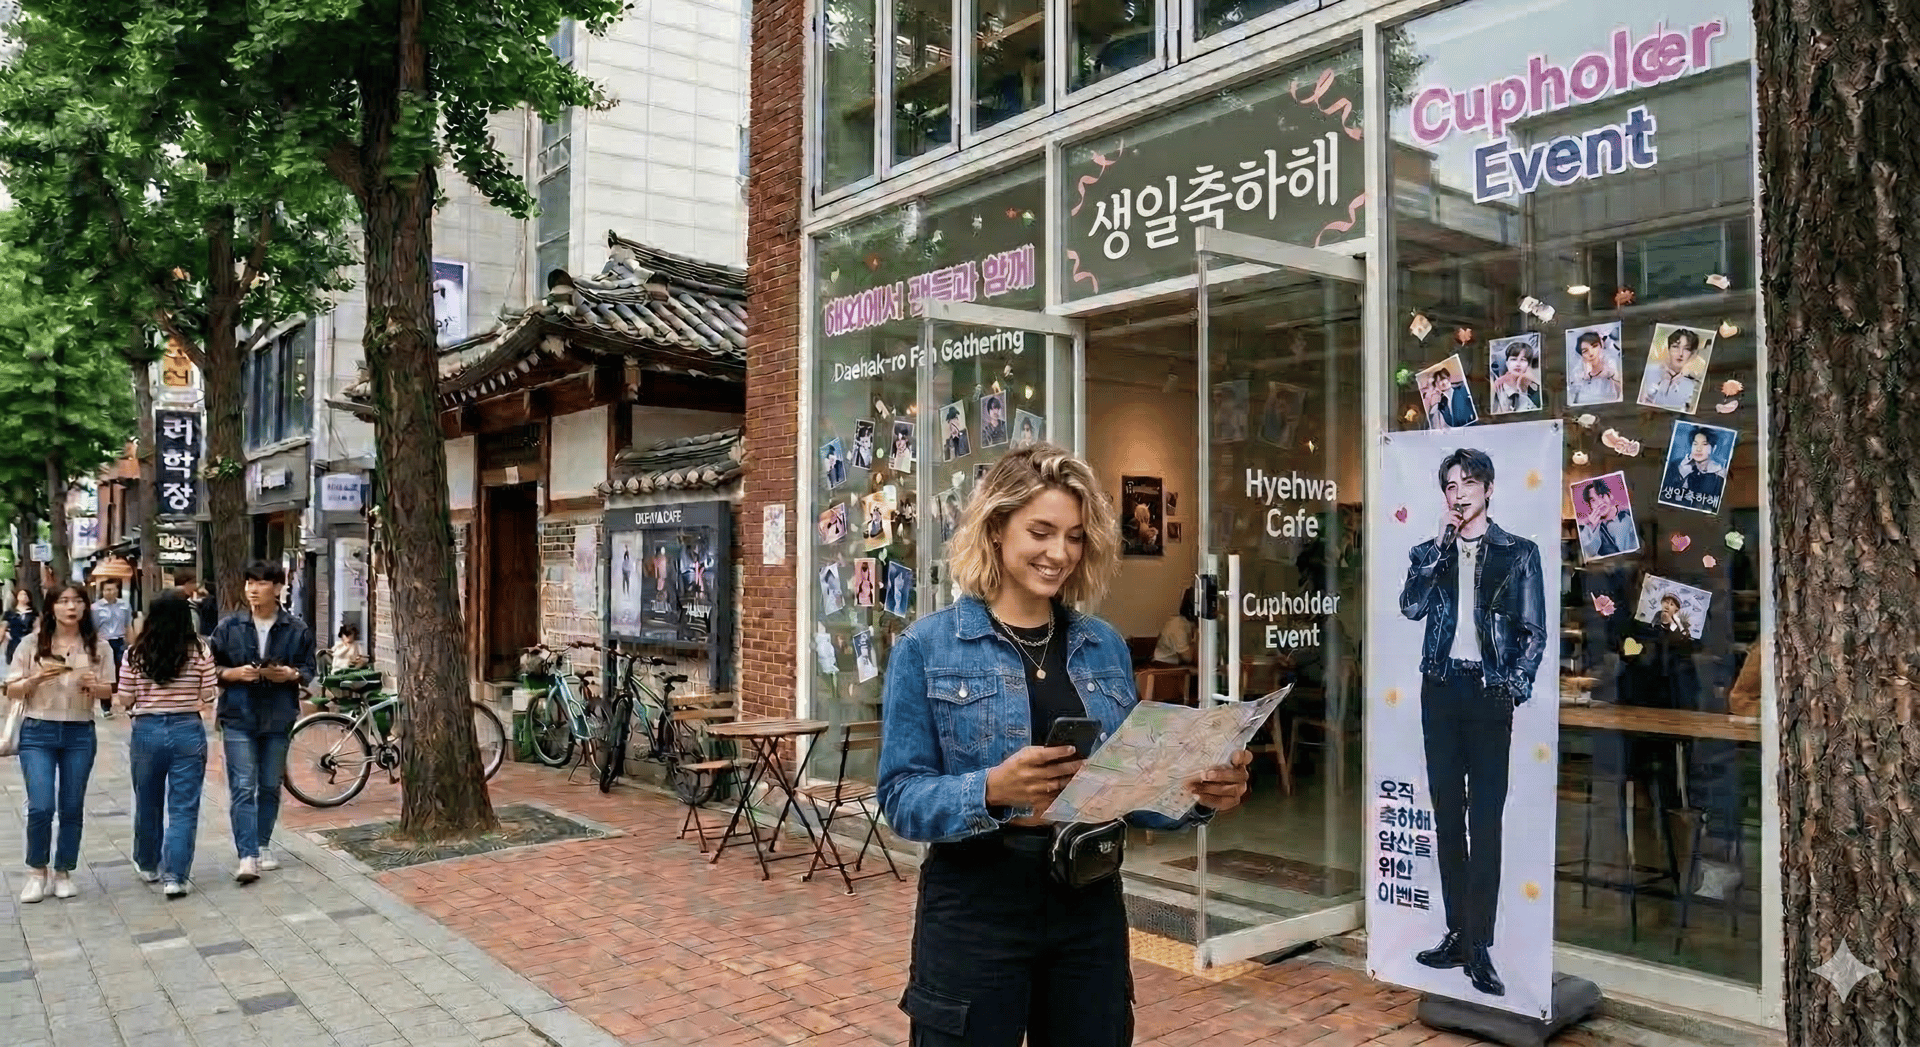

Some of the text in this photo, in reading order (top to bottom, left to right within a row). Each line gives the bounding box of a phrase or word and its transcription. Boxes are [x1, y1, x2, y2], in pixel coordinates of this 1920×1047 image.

[1473, 106, 1656, 203] Event
[1088, 131, 1338, 260] 생일축하해
[982, 243, 1034, 298] 함께
[834, 353, 906, 382] Daehak-ro
[941, 328, 1024, 362] Gathering
[1245, 468, 1337, 506] Hyehwa
[1662, 486, 1719, 509] 생일축하해
[1266, 508, 1319, 538] Cafe
[1243, 590, 1340, 622] Cupholder
[1265, 622, 1320, 649] Event
[1379, 780, 1414, 804] 오직
